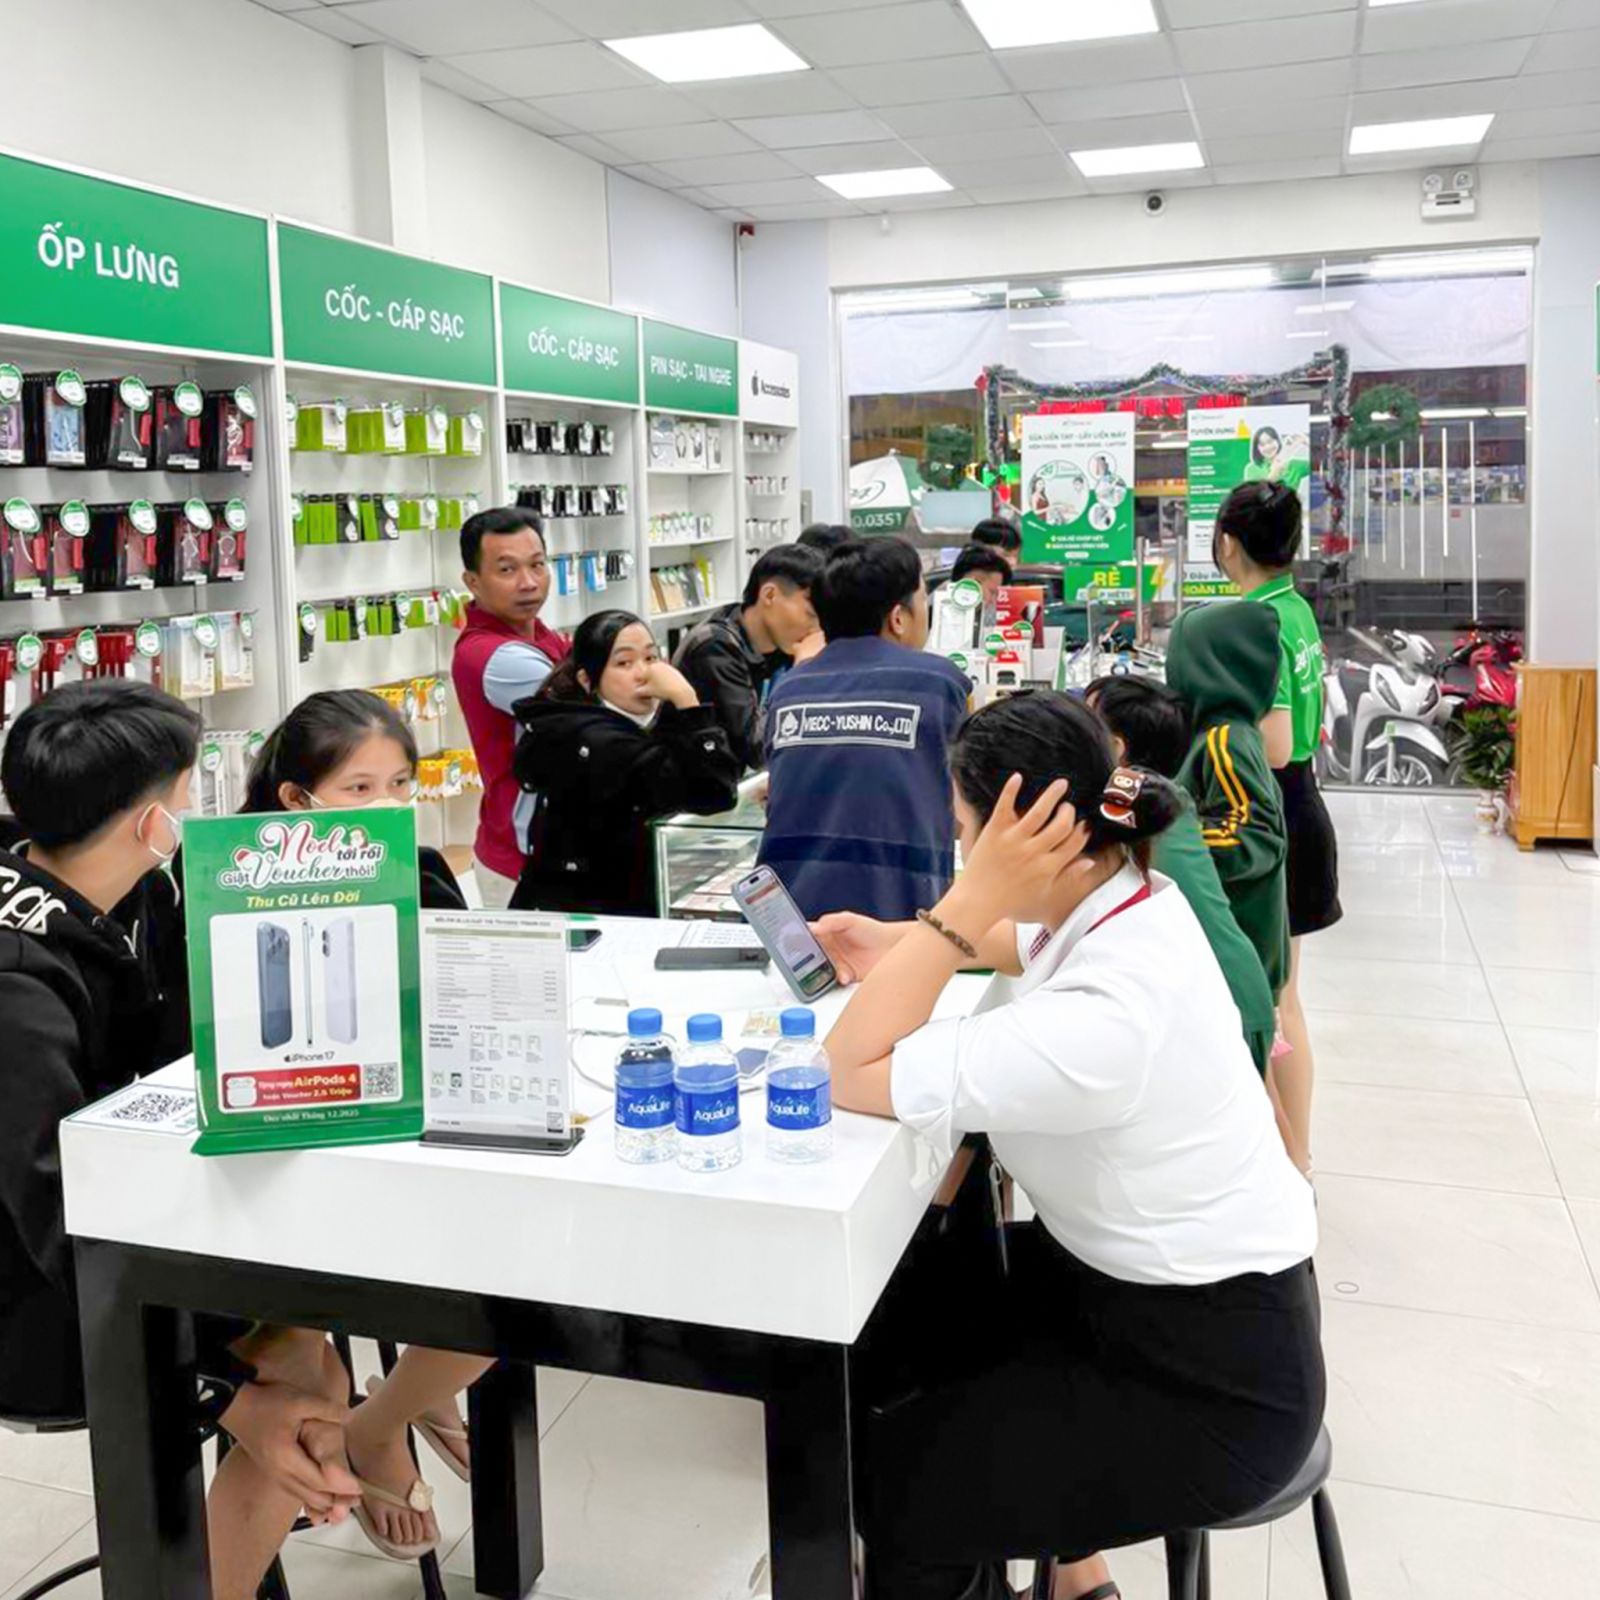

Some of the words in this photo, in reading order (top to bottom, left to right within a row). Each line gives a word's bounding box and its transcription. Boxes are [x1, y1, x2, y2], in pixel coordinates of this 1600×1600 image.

[37, 222, 85, 270] ỐP
[94, 242, 180, 288] LƯNG
[324, 284, 371, 322] CỐC
[388, 298, 425, 332] CÁP
[429, 310, 465, 342] SẠC
[528, 327, 559, 356] CỐC
[568, 336, 593, 363] CÁP
[594, 346, 619, 371] SẠC
[650, 355, 668, 376] PIN
[669, 359, 688, 383] SẠC
[694, 363, 708, 382] TAI
[708, 364, 732, 387] NGHE
[1094, 565, 1121, 586] RẺ
[336, 847, 357, 861] tới
[222, 871, 250, 887] Giật
[252, 854, 344, 886] Voucher
[345, 866, 376, 878] thôi!
[246, 896, 274, 908] Thu
[278, 892, 299, 907] Cũ
[302, 891, 329, 905] Lên
[333, 890, 361, 904] Đời
[290, 1053, 323, 1063] iPhone
[323, 1051, 335, 1061] 17
[294, 1074, 346, 1087] AirPods
[348, 1073, 357, 1083] 4
